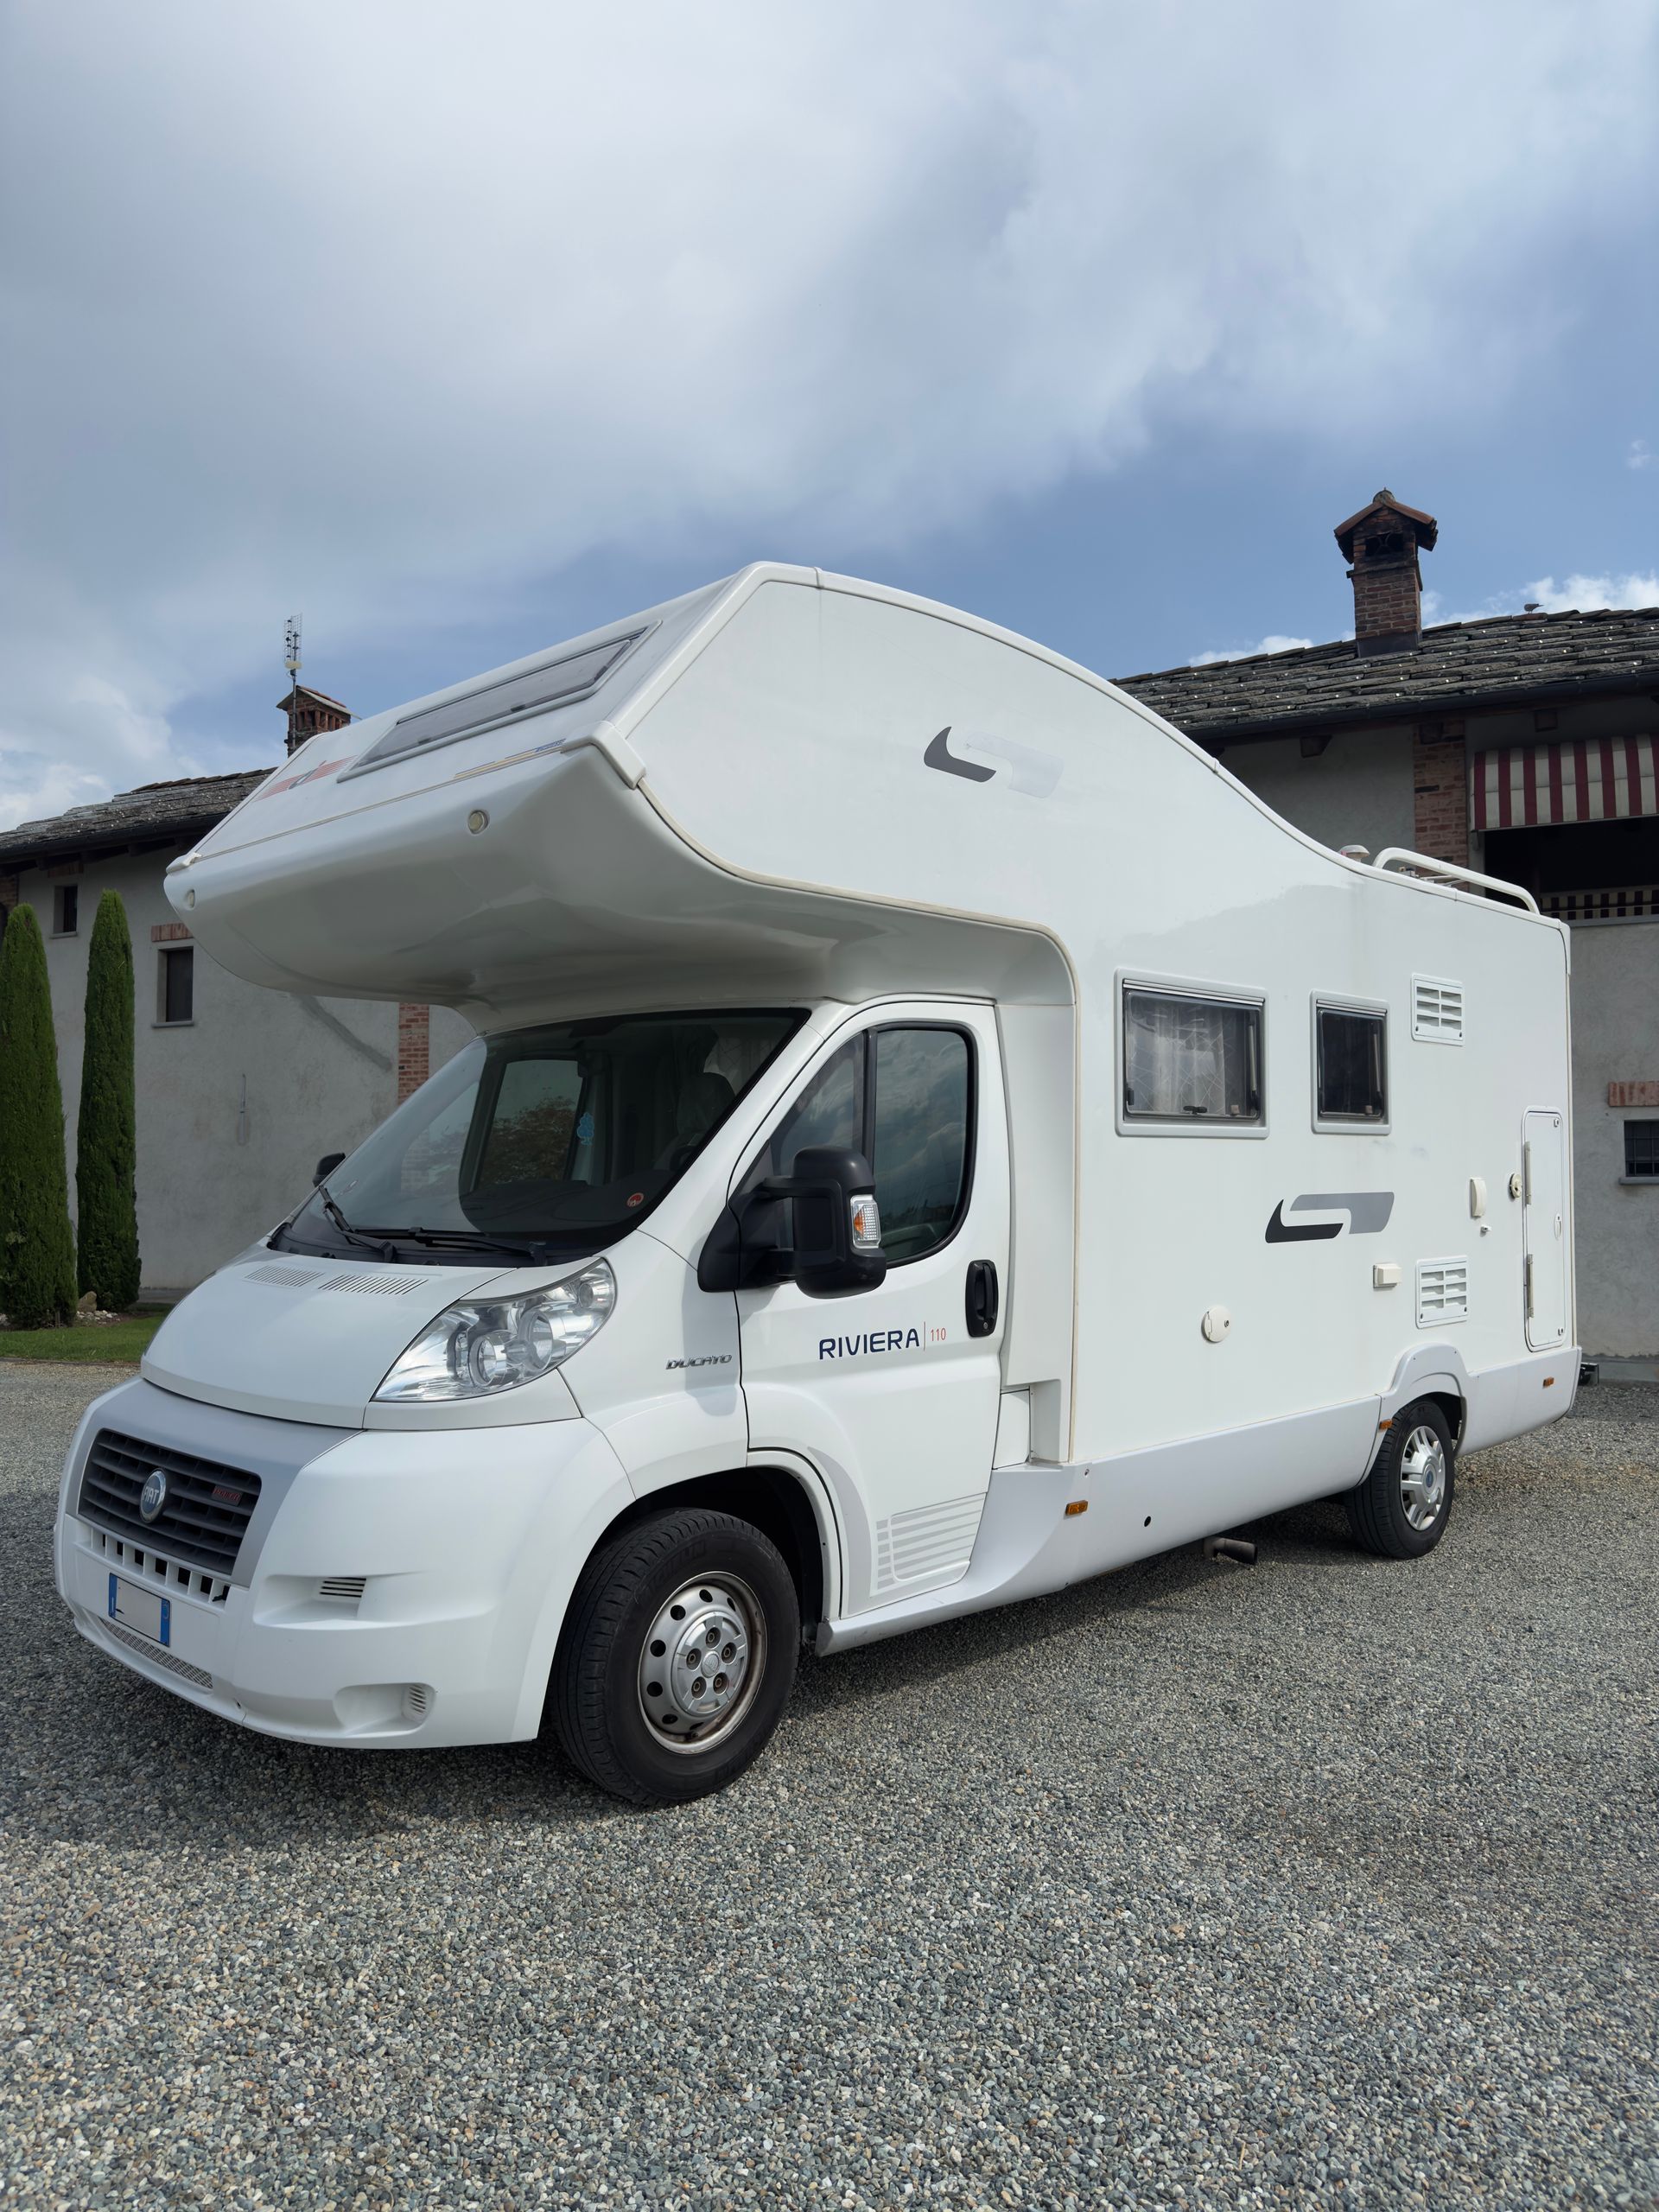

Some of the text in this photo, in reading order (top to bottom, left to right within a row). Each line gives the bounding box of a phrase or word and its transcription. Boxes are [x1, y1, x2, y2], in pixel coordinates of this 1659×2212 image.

[818, 1327, 947, 1360] RIVIERA 110
[664, 1353, 733, 1370] DUCATO
[142, 1485, 160, 1505] FIAT
